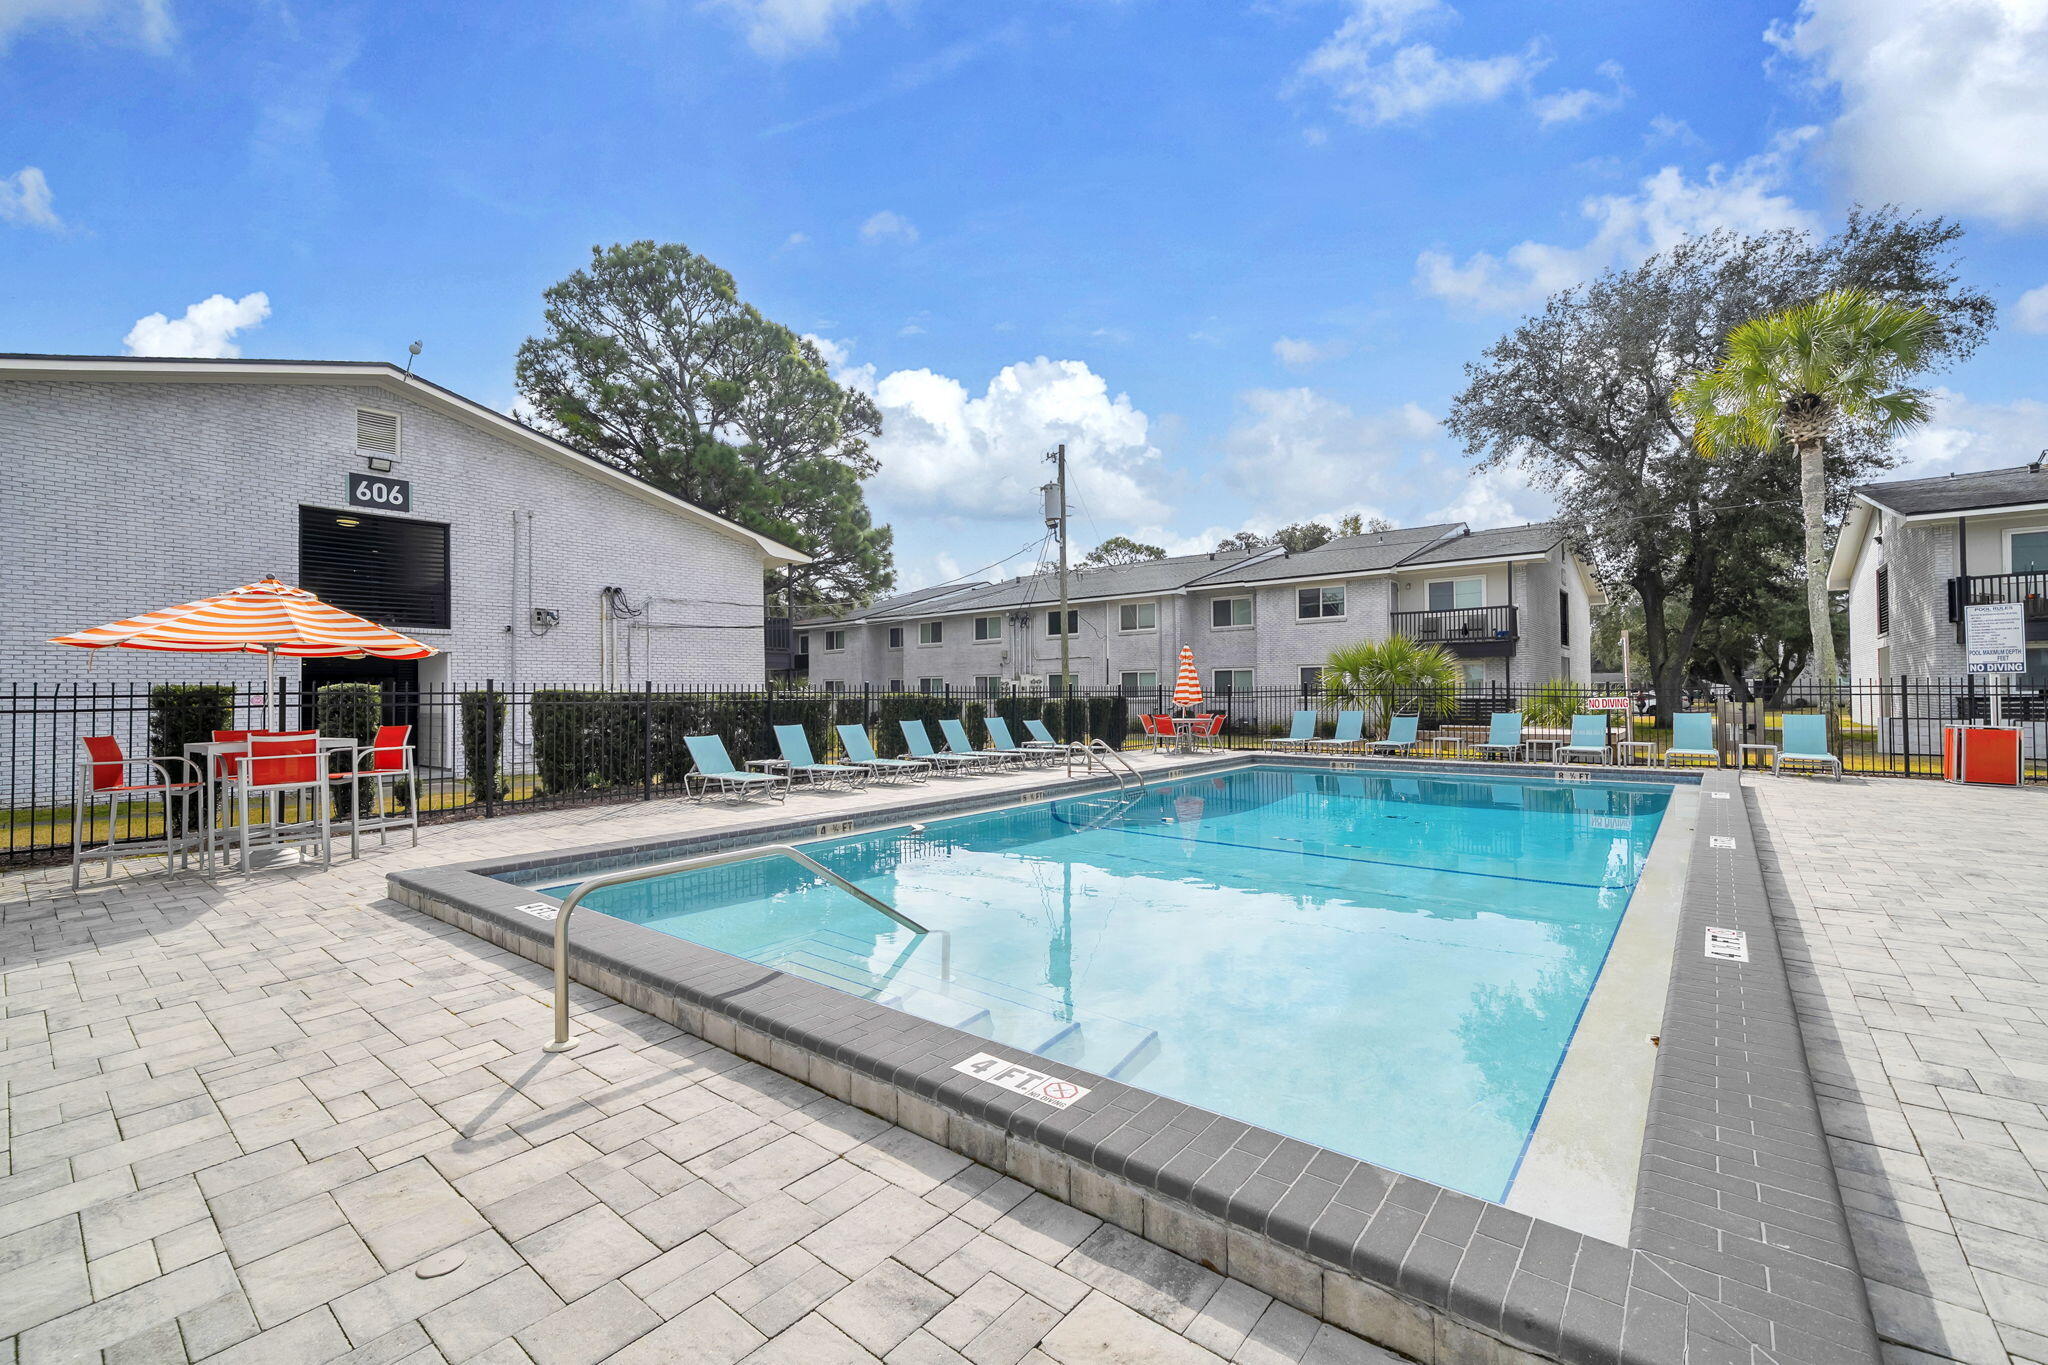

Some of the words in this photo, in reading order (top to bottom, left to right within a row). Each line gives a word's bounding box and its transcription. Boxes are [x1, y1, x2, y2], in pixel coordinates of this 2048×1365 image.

[356, 480, 404, 505] 606
[1969, 664, 1985, 672] NO
[1987, 663, 2023, 672] DIVING
[1588, 699, 1600, 708] NO
[1601, 698, 1629, 708] DIVING
[842, 821, 853, 832] FT
[970, 1059, 999, 1074] 4
[993, 1067, 1044, 1091] FT.
[1027, 1091, 1040, 1099] NO
[1039, 1095, 1068, 1108] DIVING
